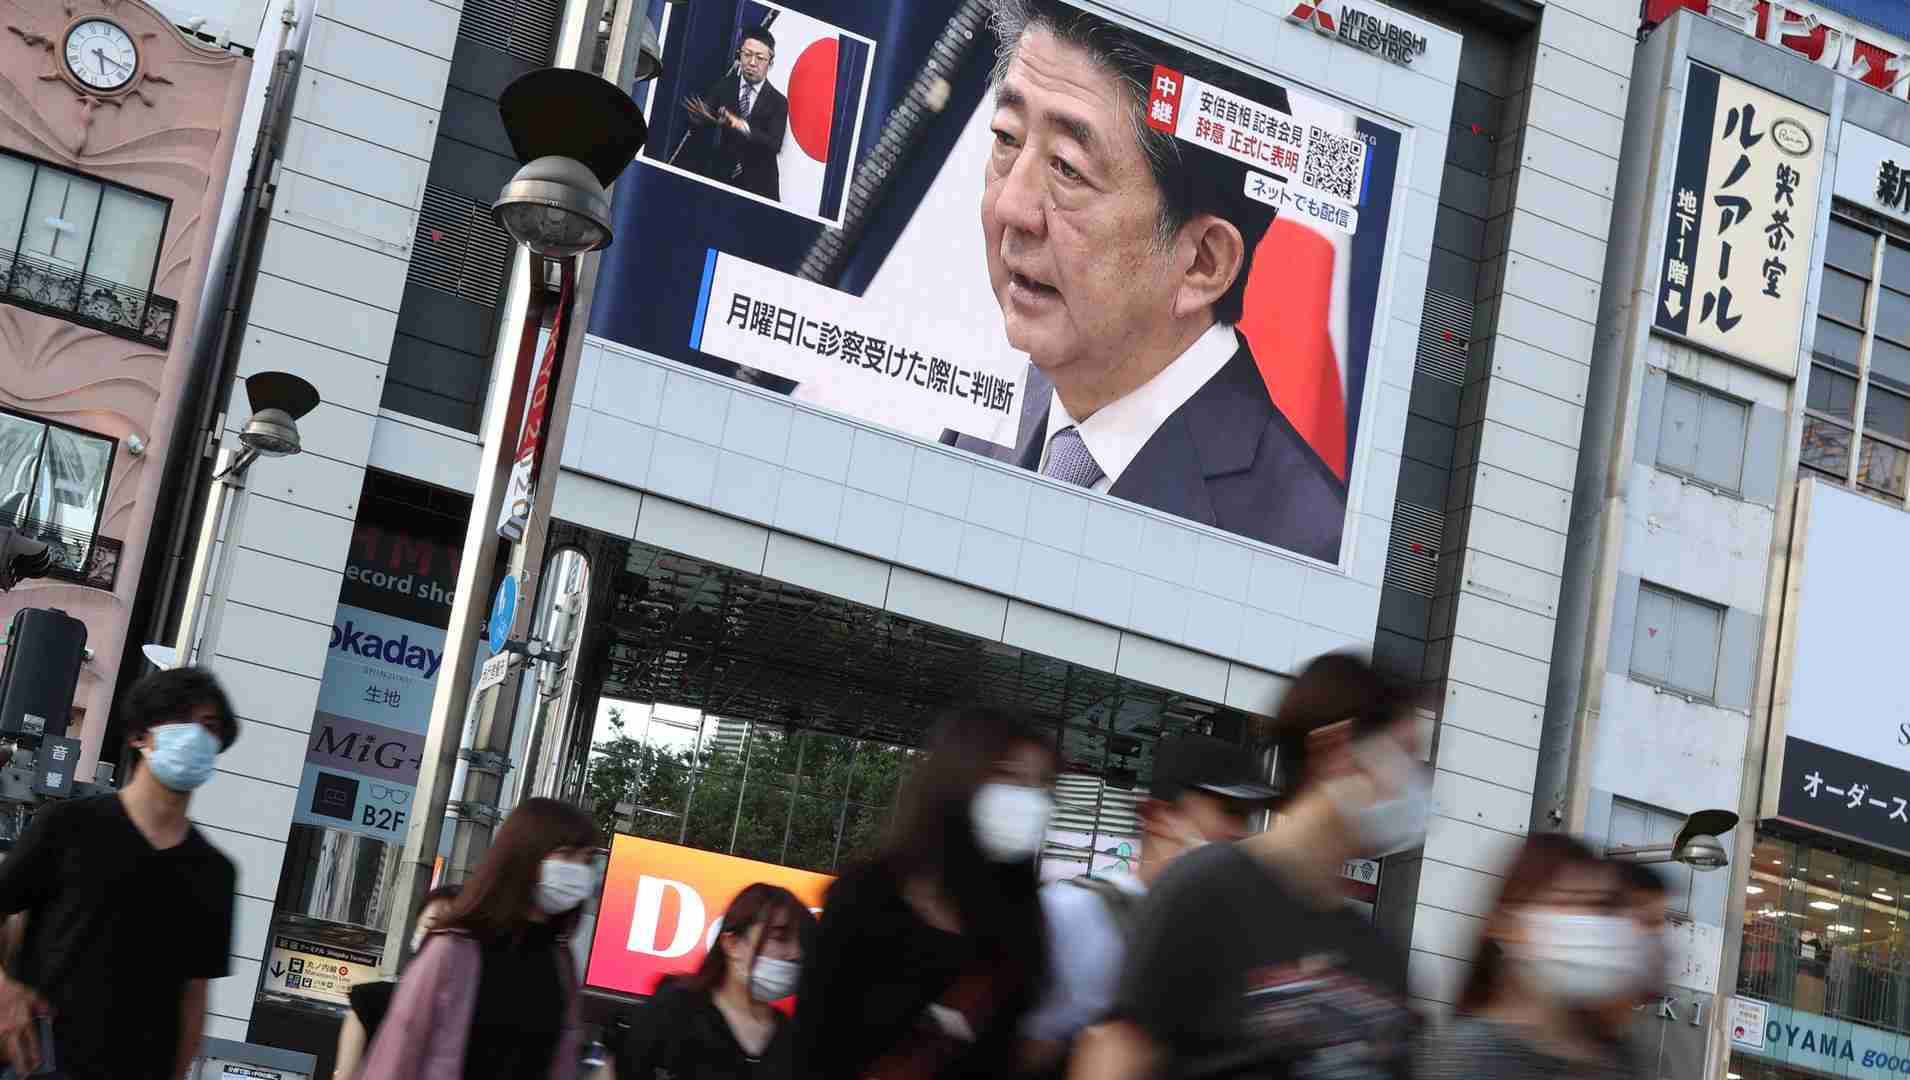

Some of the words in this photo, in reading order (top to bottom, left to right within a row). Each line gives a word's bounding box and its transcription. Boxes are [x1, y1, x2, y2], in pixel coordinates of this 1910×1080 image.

[1338, 24, 1414, 64] ELECTRIC
[1340, 5, 1428, 54] MITSUBISHI
[1151, 75, 1177, 124] 中継
[1200, 91, 1252, 127] 安倍首相
[1252, 107, 1304, 148] 記者会見
[1196, 116, 1225, 145] 辞意
[1228, 128, 1300, 173] 正式に表明
[1253, 178, 1350, 228] ネットでも配信
[1700, 103, 1765, 333] ルノアール
[1667, 187, 1697, 289] 地下1階
[1763, 162, 1800, 298] 喫茶室
[726, 292, 1016, 415] 月曜日に診察受けた際に判断
[362, 685, 401, 708] 生地
[362, 804, 406, 832] B2F
[1803, 771, 1908, 823] オーダース
[626, 874, 725, 958] D
[1766, 1020, 1855, 1062] OYAMA
